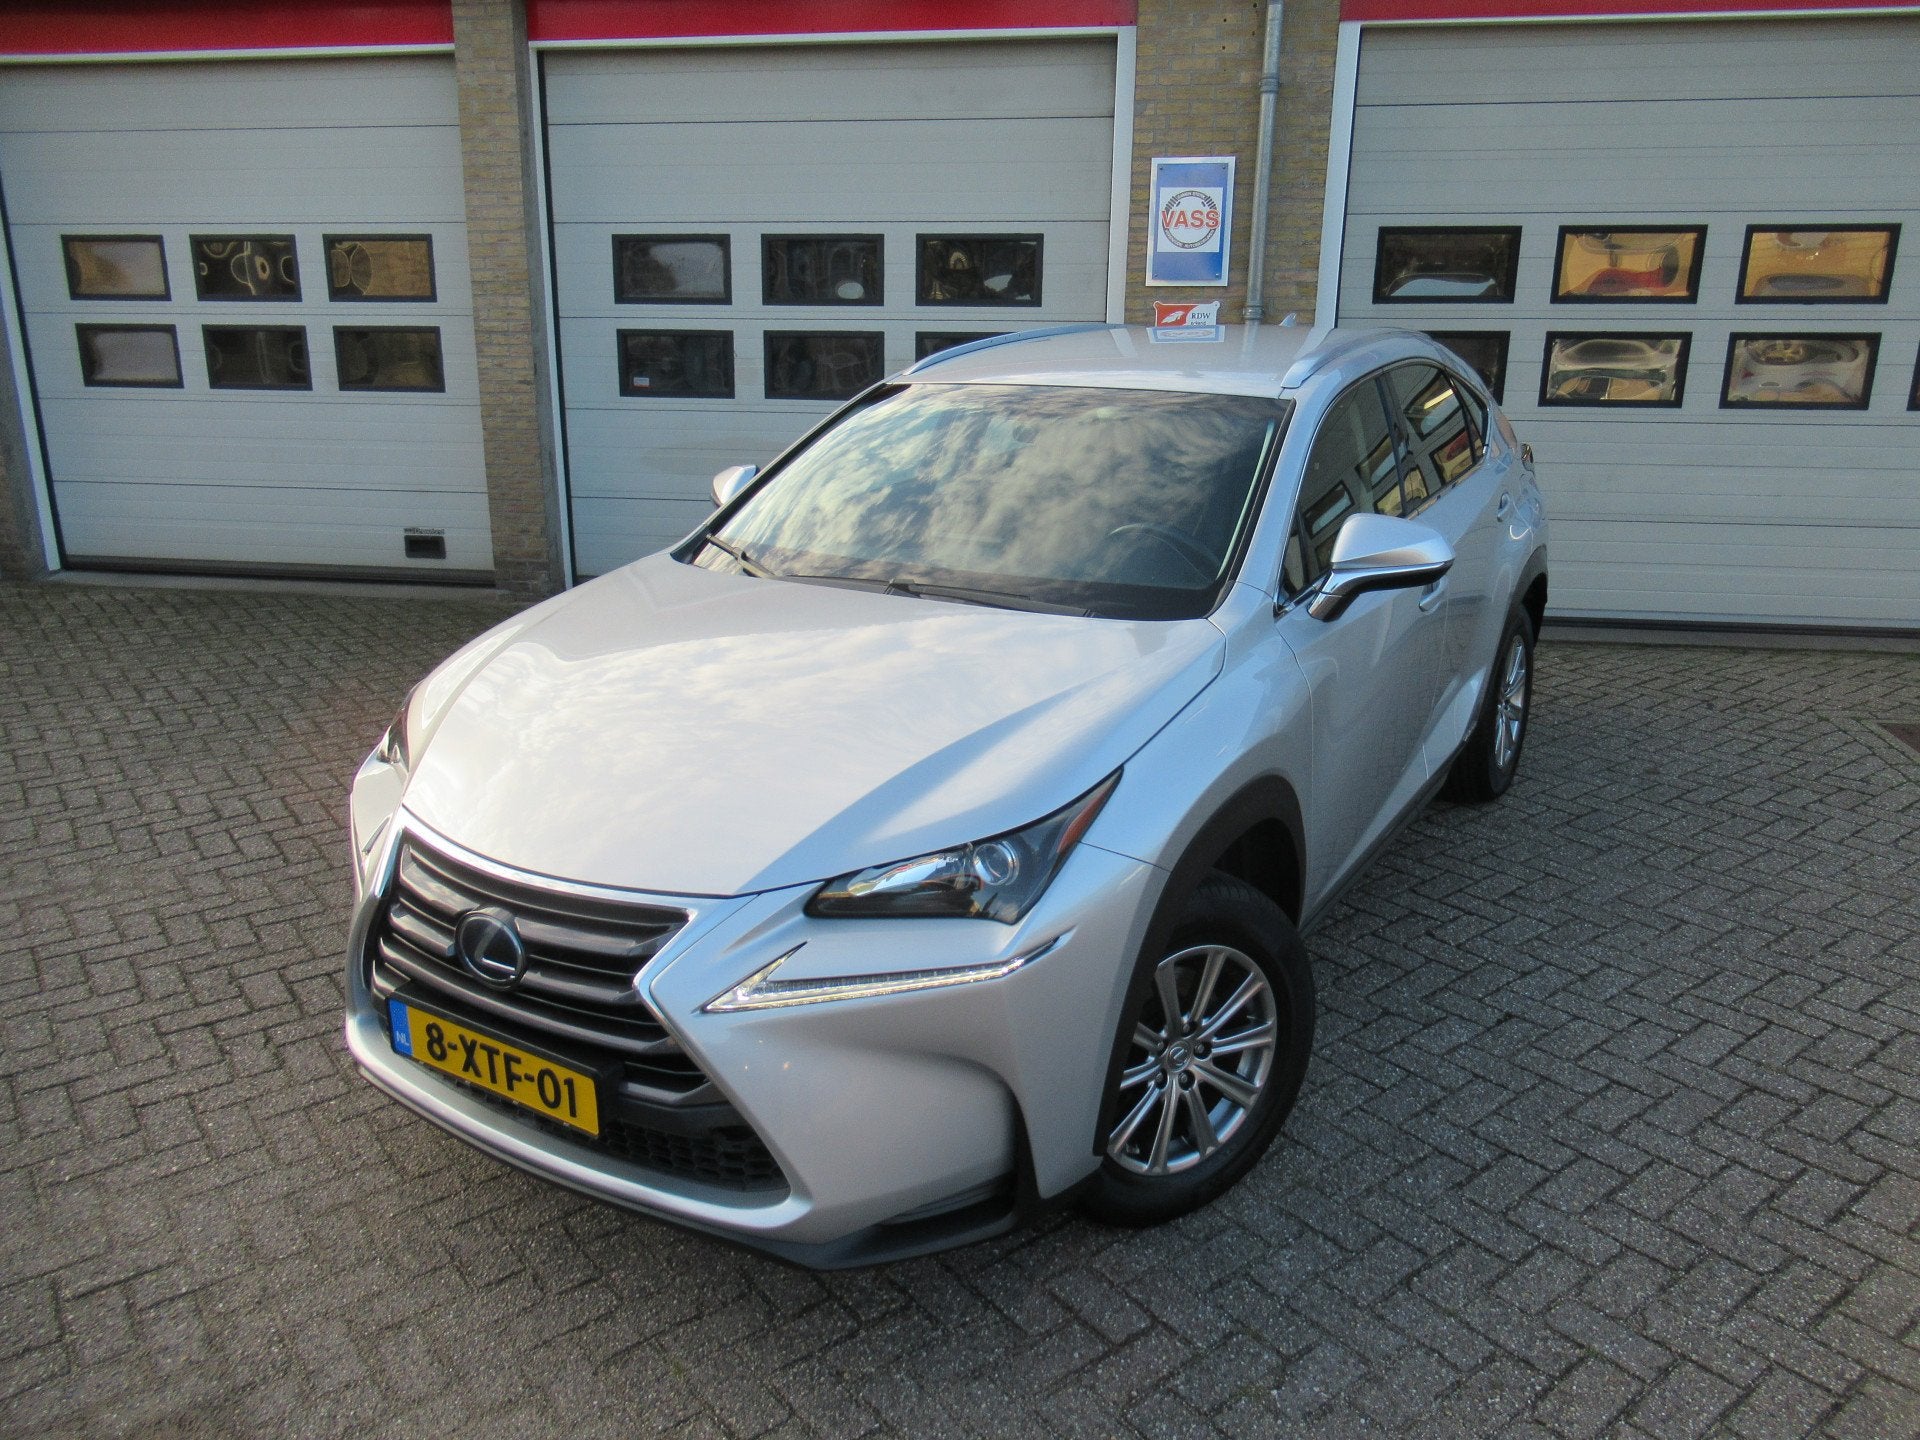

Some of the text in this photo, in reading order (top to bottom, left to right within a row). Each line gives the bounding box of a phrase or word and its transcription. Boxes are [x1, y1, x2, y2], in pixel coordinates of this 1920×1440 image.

[1161, 209, 1220, 229] VASS
[396, 1030, 410, 1047] NL
[425, 1022, 577, 1118] 8-XTF-01
